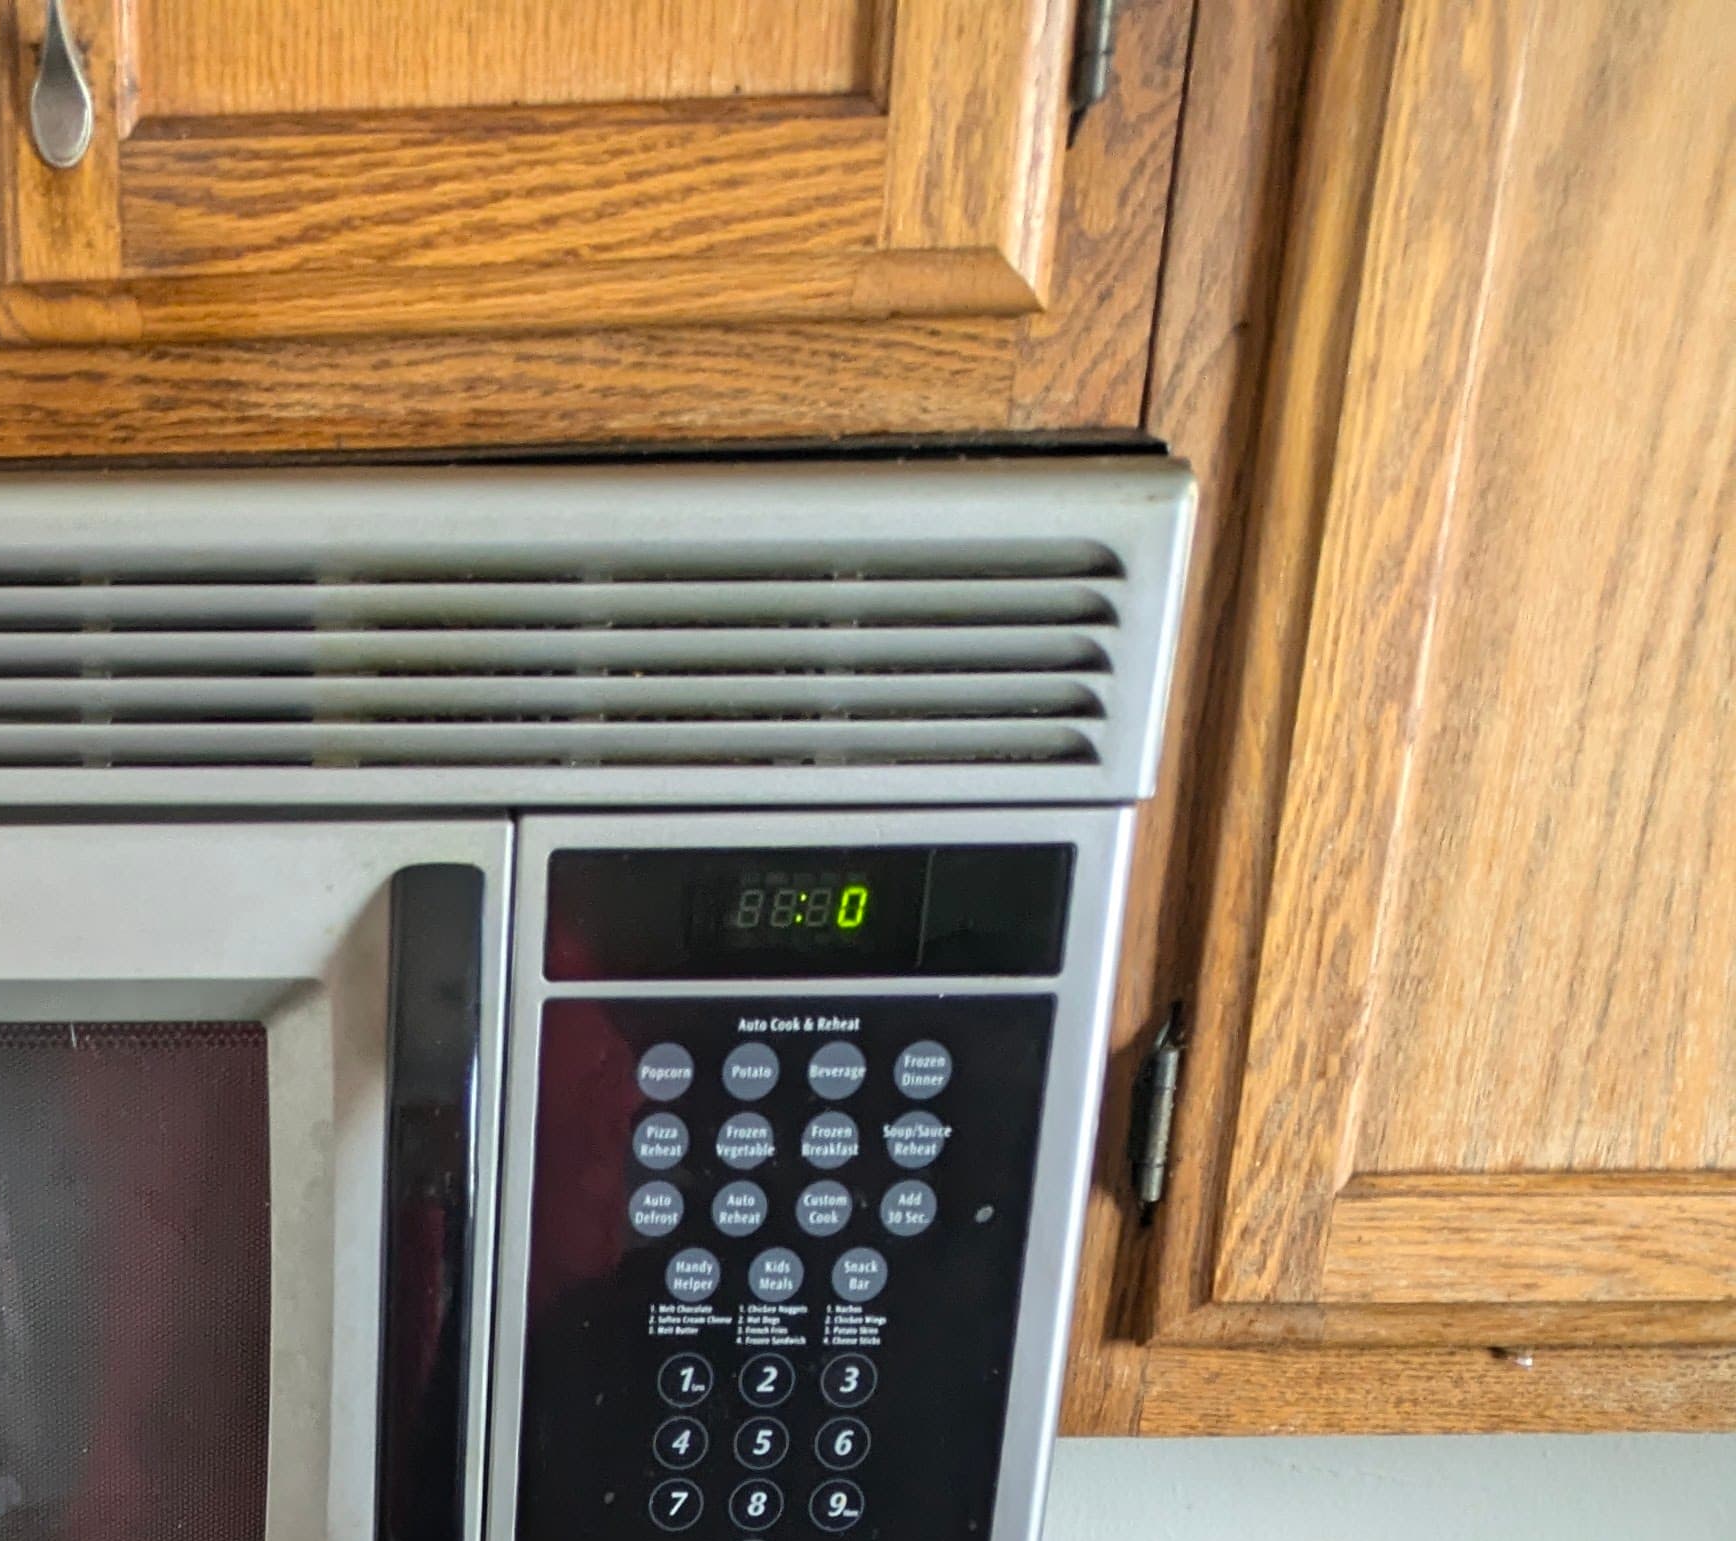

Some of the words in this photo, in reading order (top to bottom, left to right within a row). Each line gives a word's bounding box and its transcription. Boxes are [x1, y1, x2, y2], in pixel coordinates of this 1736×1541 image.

[738, 1017, 767, 1032] Auto
[770, 1017, 800, 1031] Cook
[803, 1018, 814, 1031] &
[817, 1016, 860, 1031] Reheat
[904, 1054, 946, 1068] Frozen
[641, 1066, 692, 1081] Popcorn
[732, 1064, 772, 1078] Potato
[809, 1064, 866, 1080] Beverage
[902, 1073, 944, 1087] Dinner
[646, 1126, 678, 1139] Pizza
[726, 1126, 768, 1139] Frozen
[812, 1125, 852, 1138] Frozen
[883, 1124, 952, 1140] Soup/Sauce
[640, 1143, 682, 1157] Reheat
[716, 1142, 775, 1159] Vegetable
[801, 1142, 859, 1157] Breakfast
[894, 1141, 936, 1156] Reheat
[643, 1195, 672, 1207] Auto
[726, 1194, 755, 1207] Auto
[803, 1194, 848, 1207] Custom
[898, 1192, 923, 1206] Add
[635, 1211, 678, 1225] Defrost
[719, 1211, 761, 1225] Reheat
[809, 1211, 839, 1224] Cook
[888, 1211, 902, 1224] 30
[676, 1260, 713, 1275] Handy
[765, 1260, 790, 1274] Kids
[843, 1260, 878, 1273] Snack
[673, 1277, 713, 1293] Helper
[759, 1278, 793, 1290] Meals
[848, 1278, 871, 1290] Bar
[680, 1366, 694, 1392] 1
[756, 1366, 778, 1393] 2
[839, 1366, 860, 1393] 3
[671, 1429, 691, 1455] 4
[752, 1429, 773, 1456] 5
[834, 1429, 854, 1456] 6
[669, 1491, 689, 1516] 7
[747, 1491, 768, 1517] 8
[828, 1492, 847, 1517] 9
